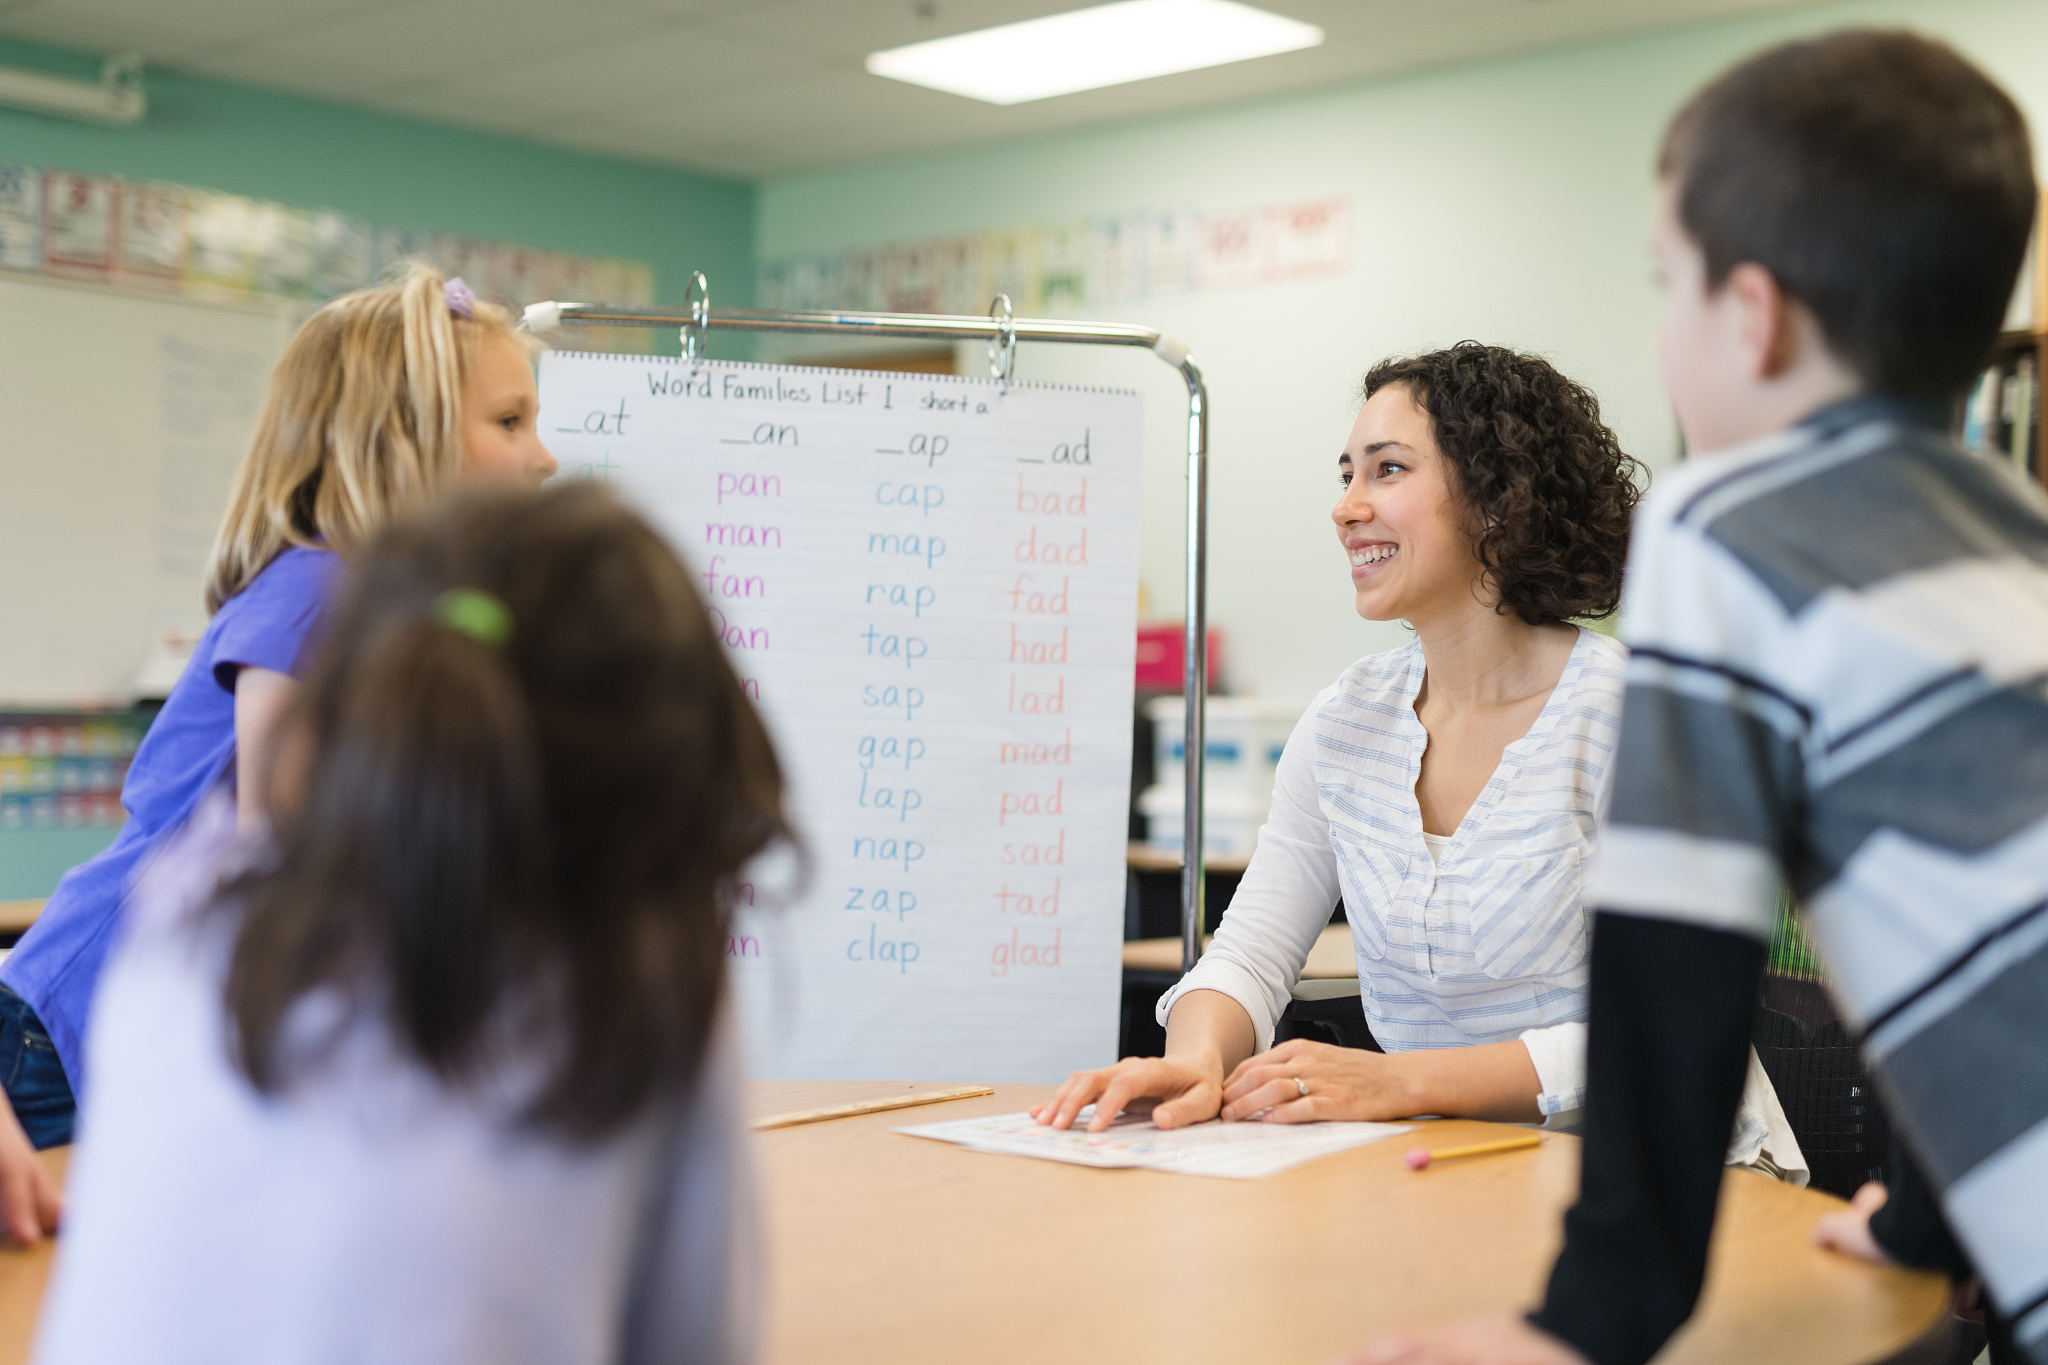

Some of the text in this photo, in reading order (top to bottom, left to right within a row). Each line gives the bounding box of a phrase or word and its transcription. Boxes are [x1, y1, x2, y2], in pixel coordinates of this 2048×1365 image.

[647, 370, 712, 399] Word
[722, 374, 811, 402] Families
[822, 381, 868, 404] List
[919, 390, 968, 412] short
[976, 402, 989, 414] a
[717, 472, 781, 505] pan
[876, 481, 945, 517] cap
[1016, 473, 1088, 515] bad
[706, 522, 781, 547] man
[868, 532, 946, 569] map
[1014, 524, 1088, 565] dad
[702, 554, 765, 598] fan
[1008, 572, 1069, 614] fad
[866, 583, 936, 618] rap
[860, 622, 928, 669] tap
[1009, 621, 1068, 664] had
[863, 684, 925, 721] sap
[1008, 673, 1065, 714] lad
[857, 735, 926, 771] gap
[1000, 727, 1071, 765] mad
[858, 769, 923, 822] lap
[1000, 778, 1063, 825] pad
[853, 836, 926, 872] nap
[1000, 828, 1065, 866] sad
[845, 886, 917, 922] zap
[993, 877, 1060, 917] tad
[846, 922, 920, 974] clap
[990, 926, 1061, 978] glad
